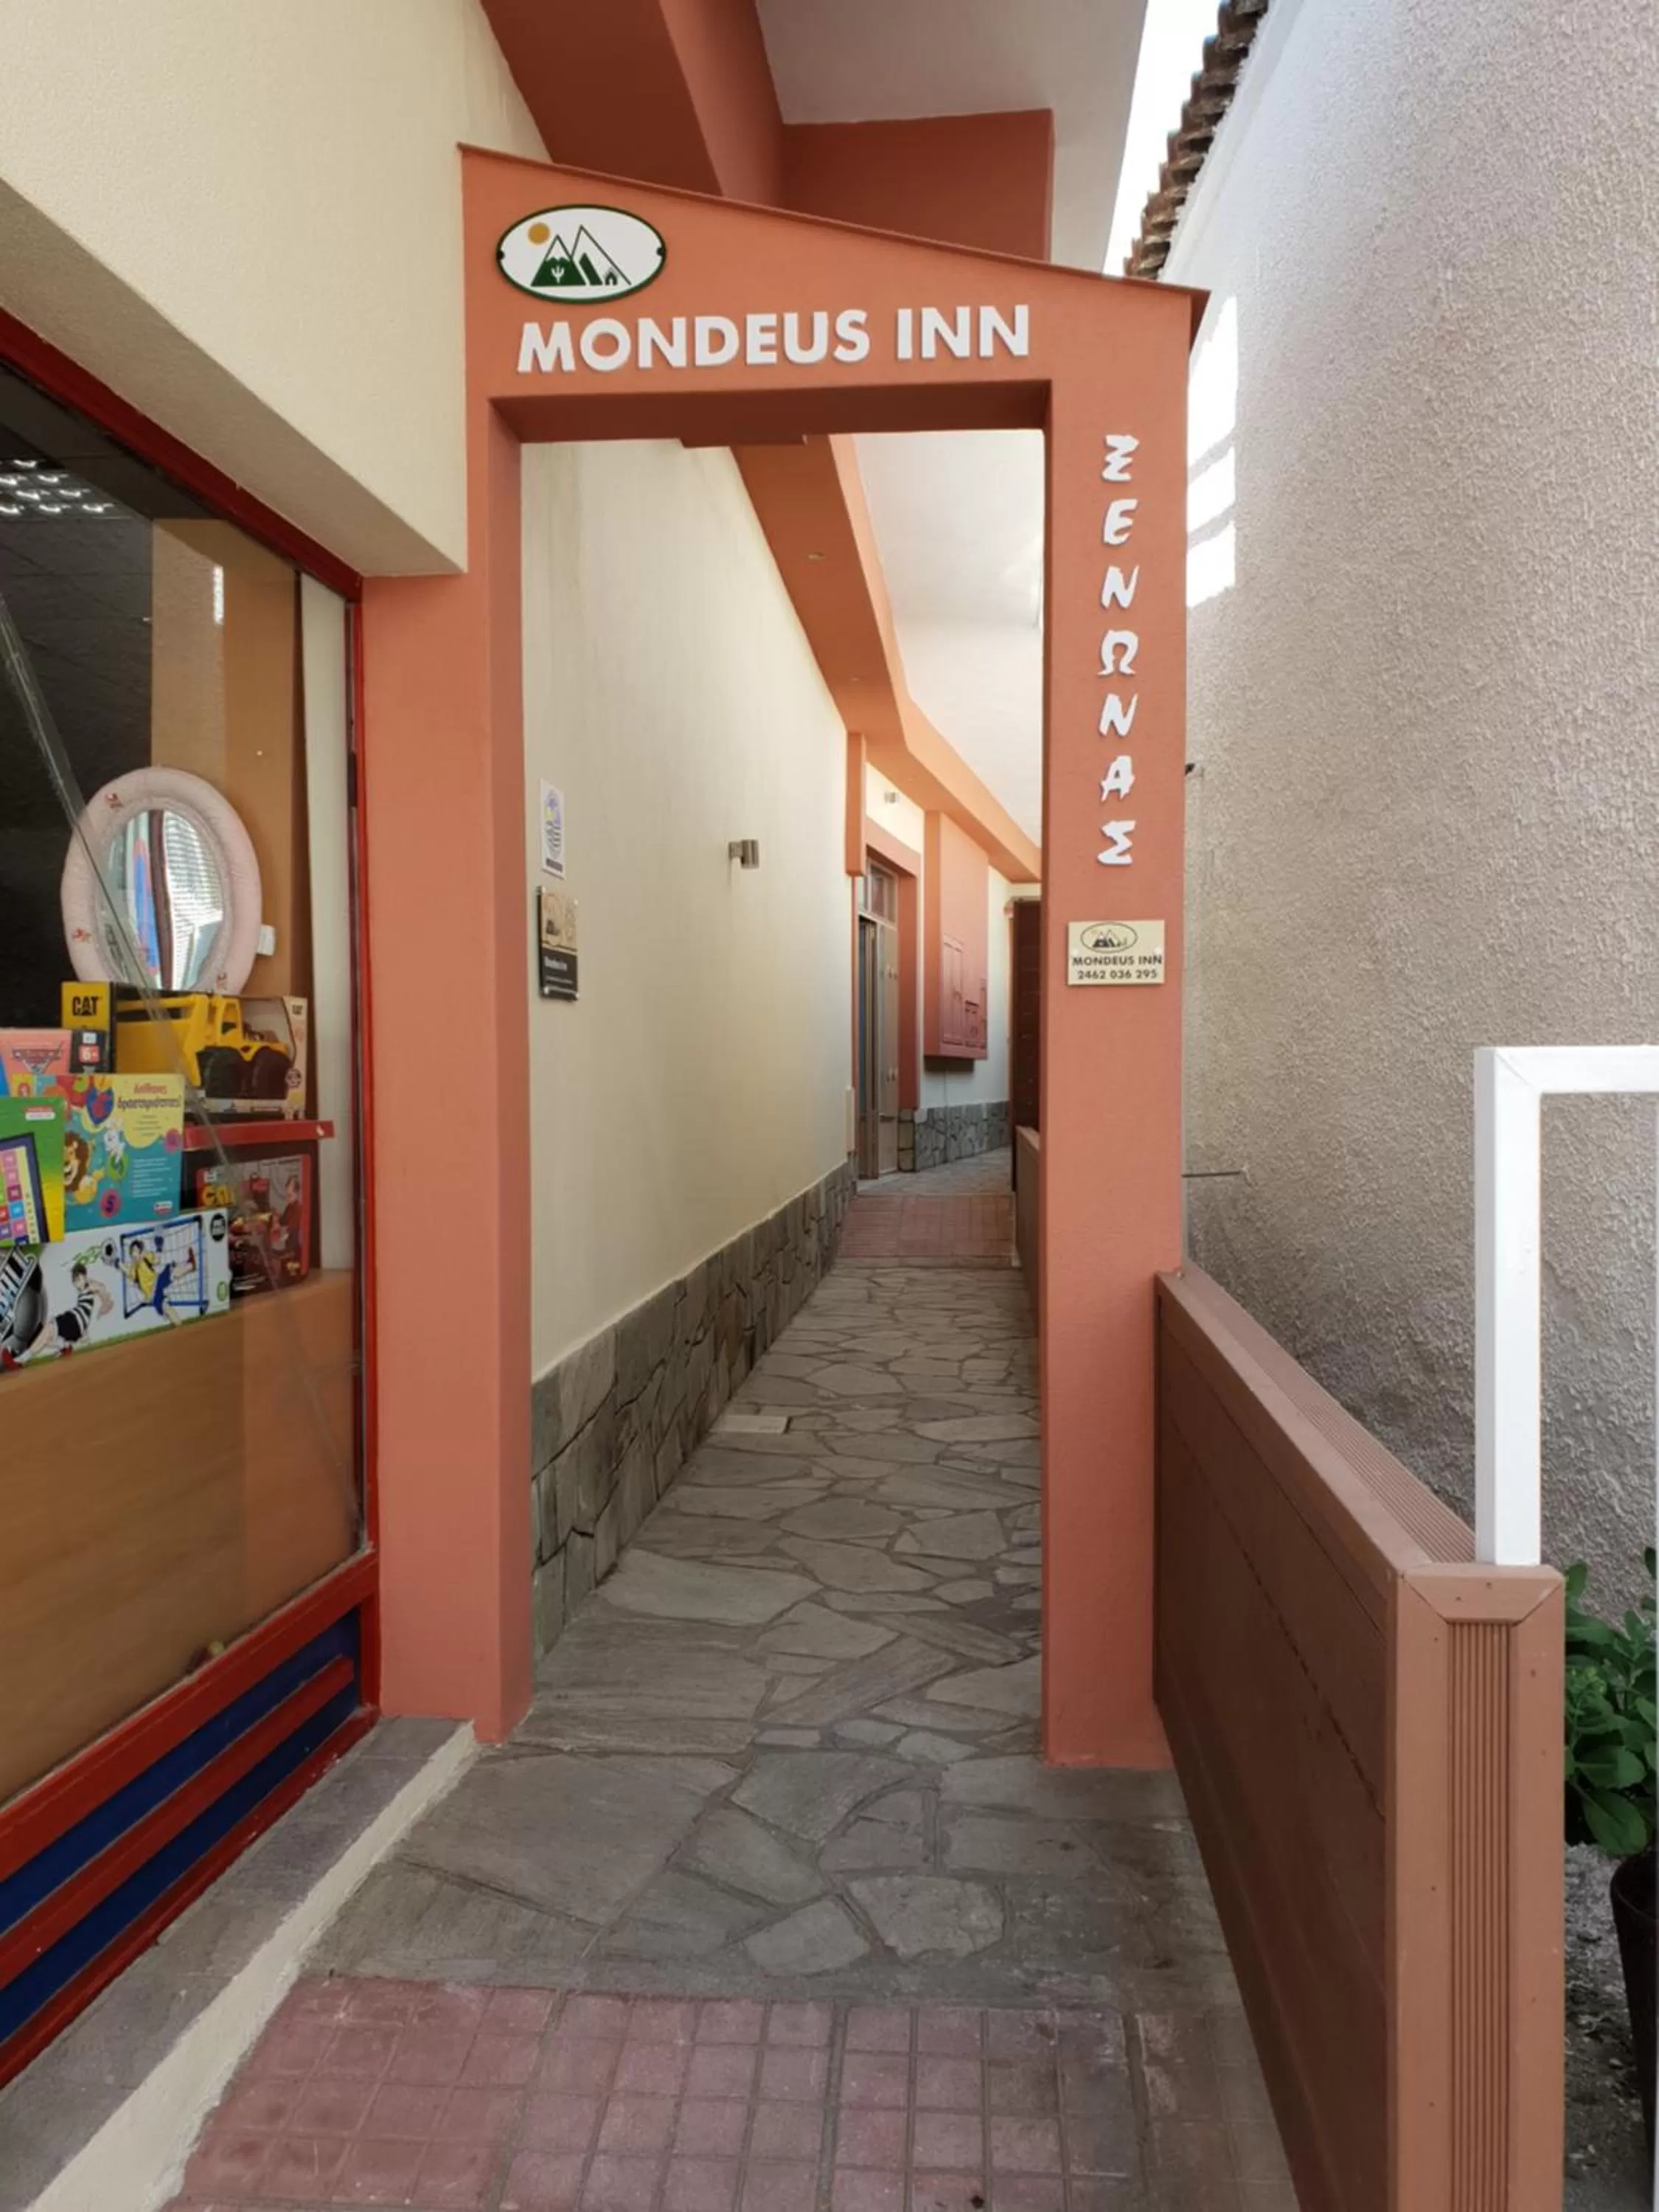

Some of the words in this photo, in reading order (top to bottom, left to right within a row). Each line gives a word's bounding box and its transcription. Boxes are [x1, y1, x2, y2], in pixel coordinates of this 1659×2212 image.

[517, 309, 871, 373] MONDEUS
[897, 305, 1030, 360] INN
[1097, 434, 1140, 865] ΞΕΝΩΝΑΣ
[1072, 956, 1135, 966] MONDEUS
[1138, 955, 1163, 965] INN
[1078, 970, 1106, 980] 2462
[1110, 970, 1131, 979] 036
[1135, 969, 1157, 979] 295
[72, 996, 98, 1016] CAT
